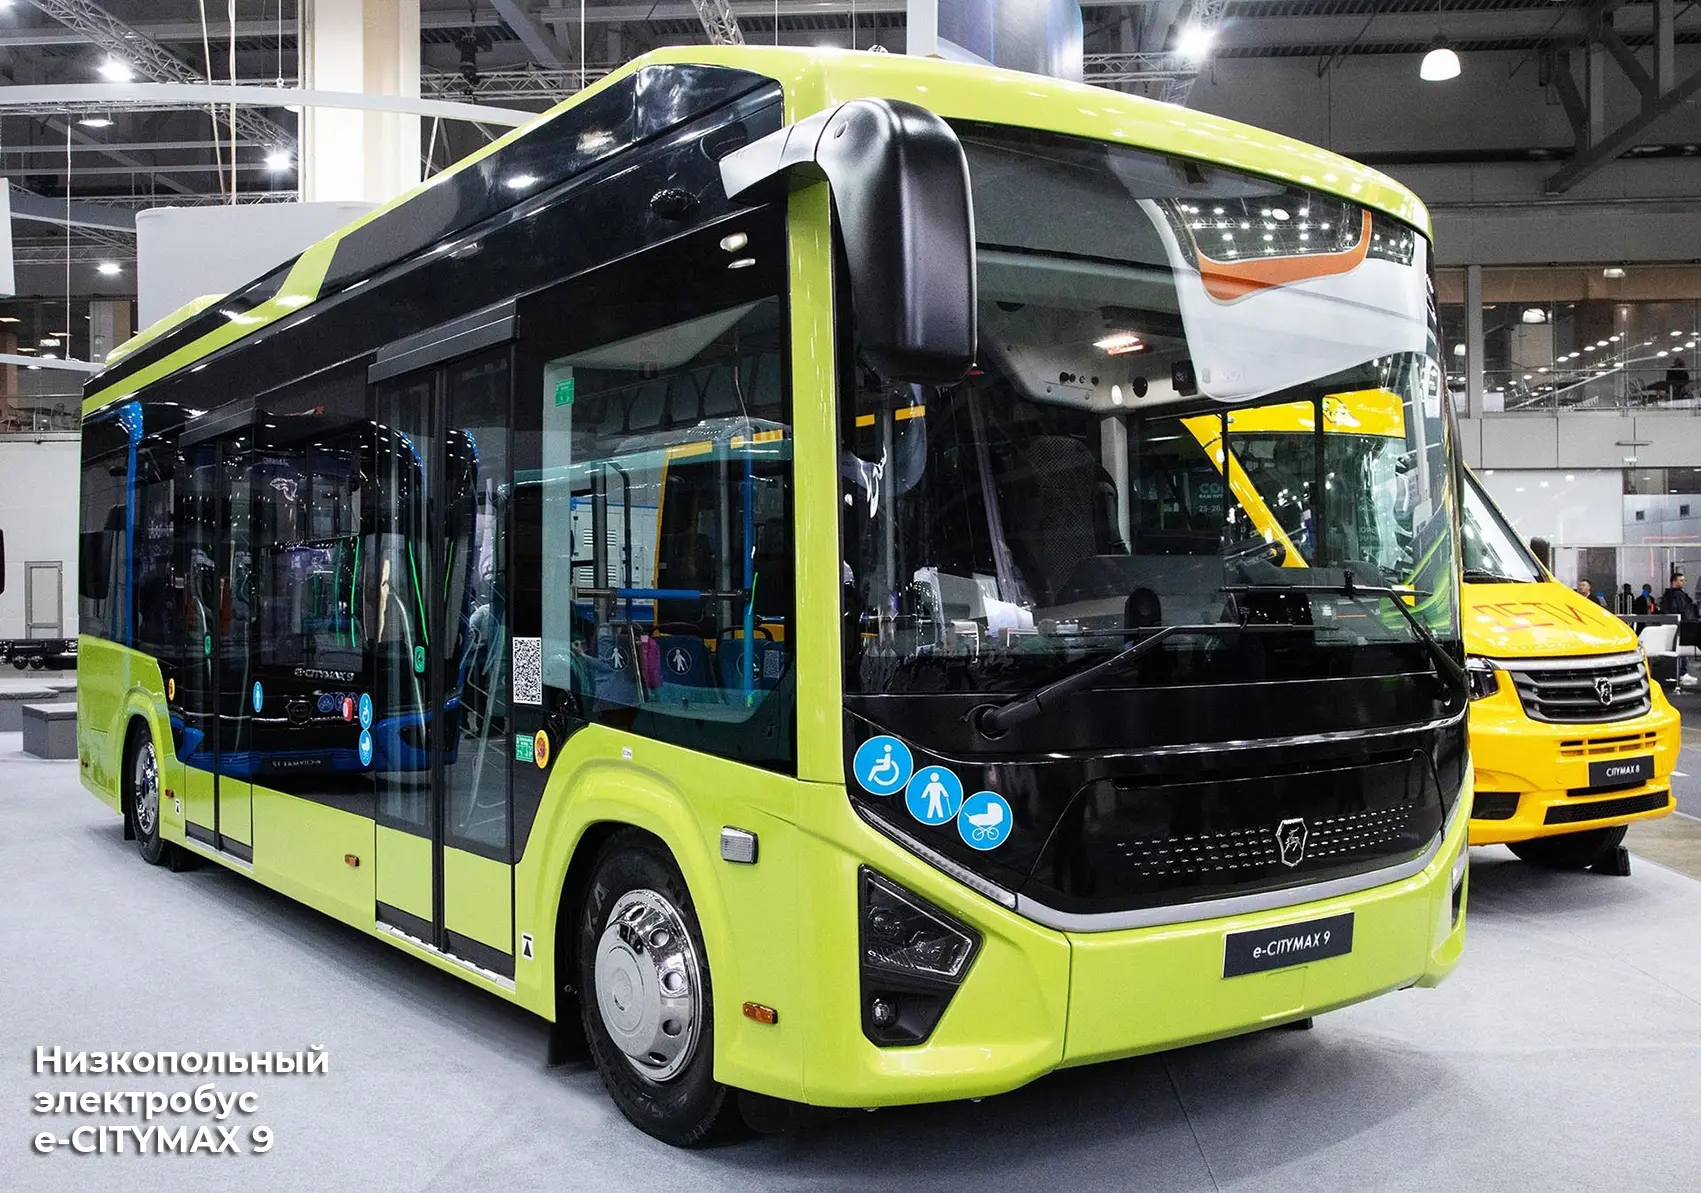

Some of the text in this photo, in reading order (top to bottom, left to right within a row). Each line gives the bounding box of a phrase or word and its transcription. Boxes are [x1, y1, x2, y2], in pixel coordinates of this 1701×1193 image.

[1472, 602, 1608, 632] ДЕТИ
[1606, 764, 1641, 777] CITYMAX 8
[1253, 930, 1331, 959] e-CITYMAX 9
